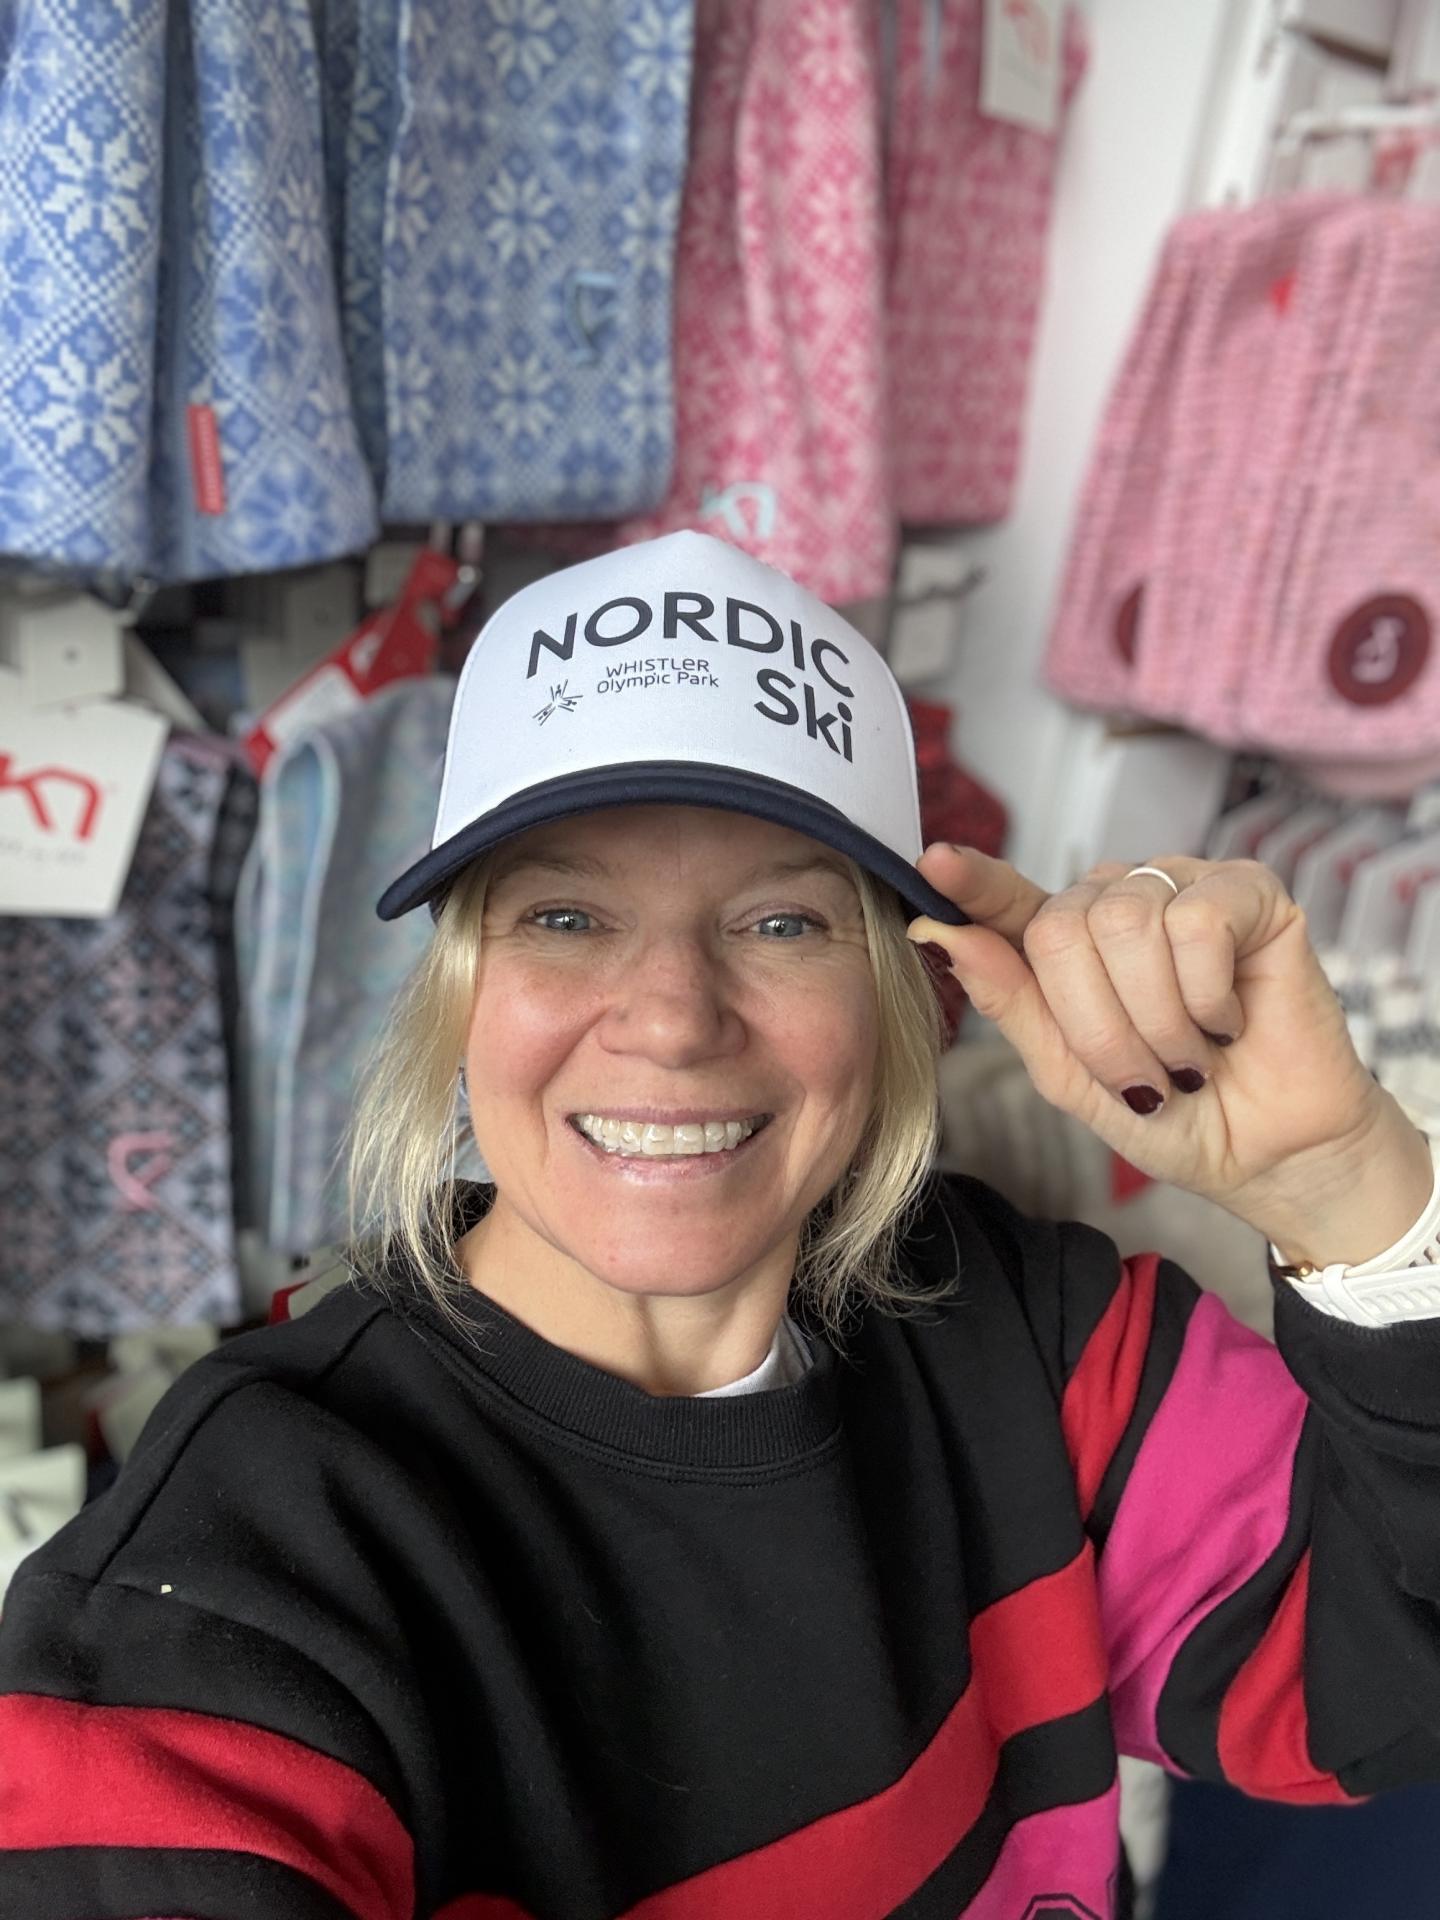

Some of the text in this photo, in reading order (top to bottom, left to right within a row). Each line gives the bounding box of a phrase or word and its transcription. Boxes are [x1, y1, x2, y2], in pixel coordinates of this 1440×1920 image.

[526, 591, 855, 699] NORDIC
[596, 671, 719, 694] Olympic Park
[753, 668, 854, 764] Ski
